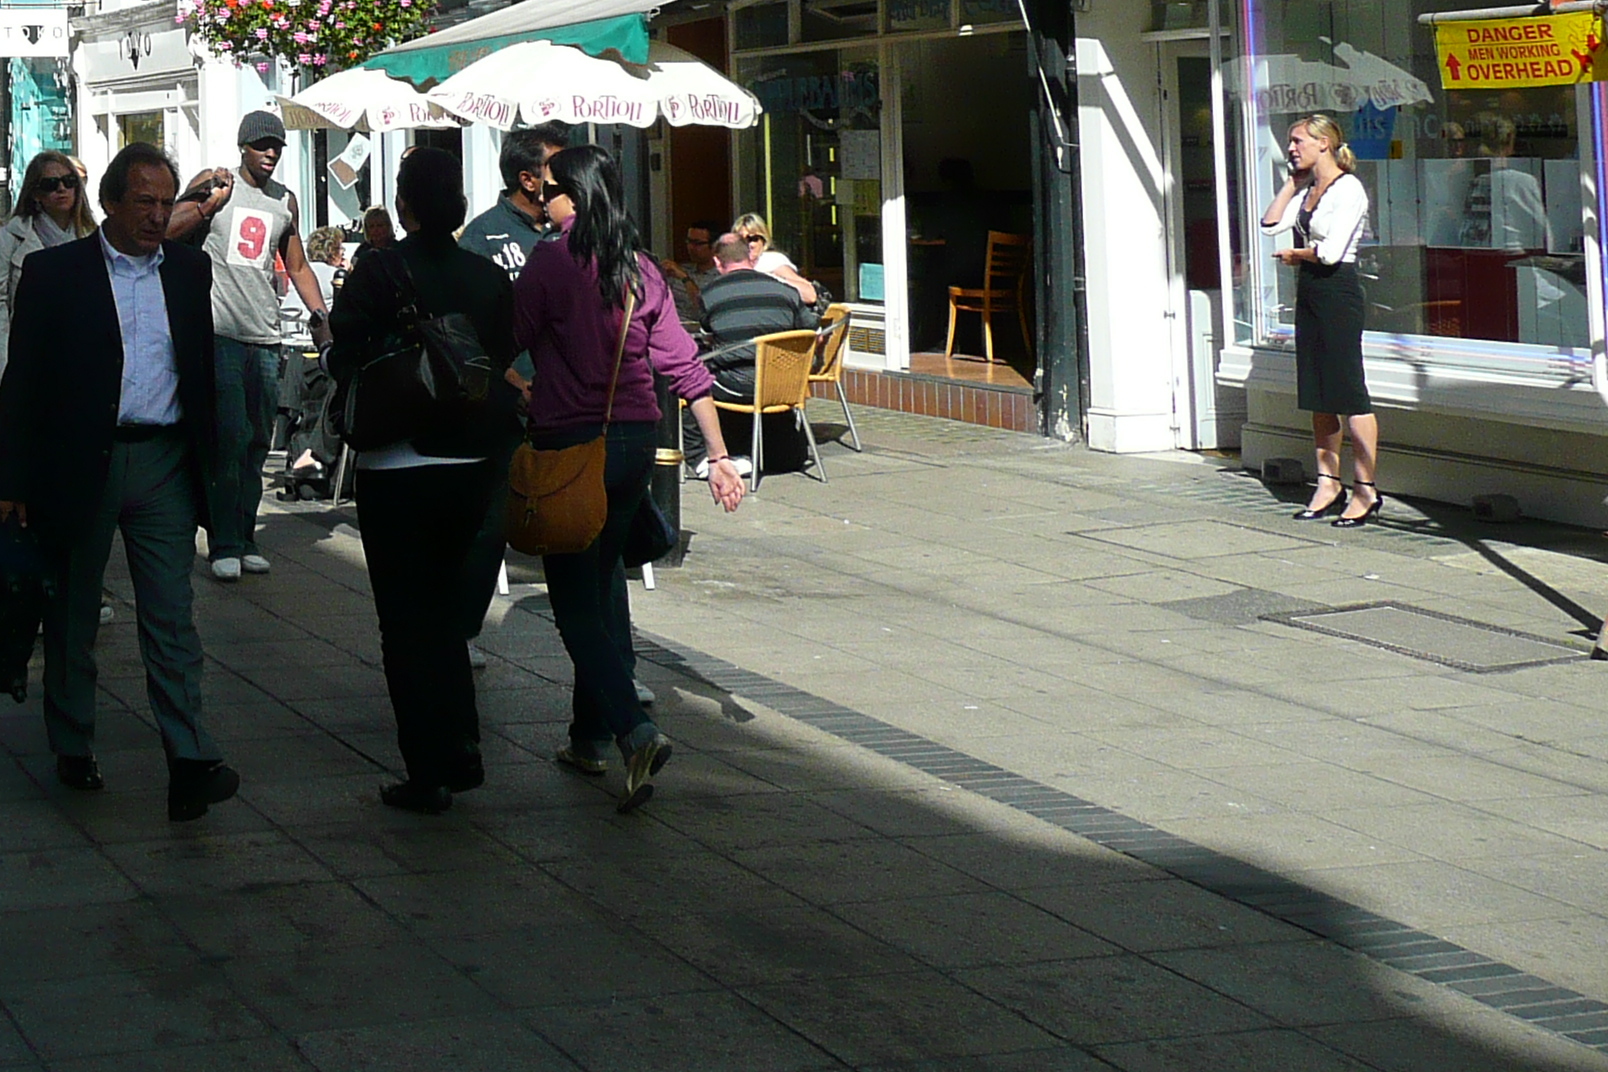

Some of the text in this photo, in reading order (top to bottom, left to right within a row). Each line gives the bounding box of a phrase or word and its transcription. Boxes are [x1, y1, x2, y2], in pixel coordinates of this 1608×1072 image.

[1467, 24, 1554, 43] DANGER
[1468, 43, 1561, 61] MEN WORKING
[1467, 59, 1574, 81] OVERHEAD
[572, 95, 642, 123] PORTIOLI
[237, 216, 266, 260] 9
